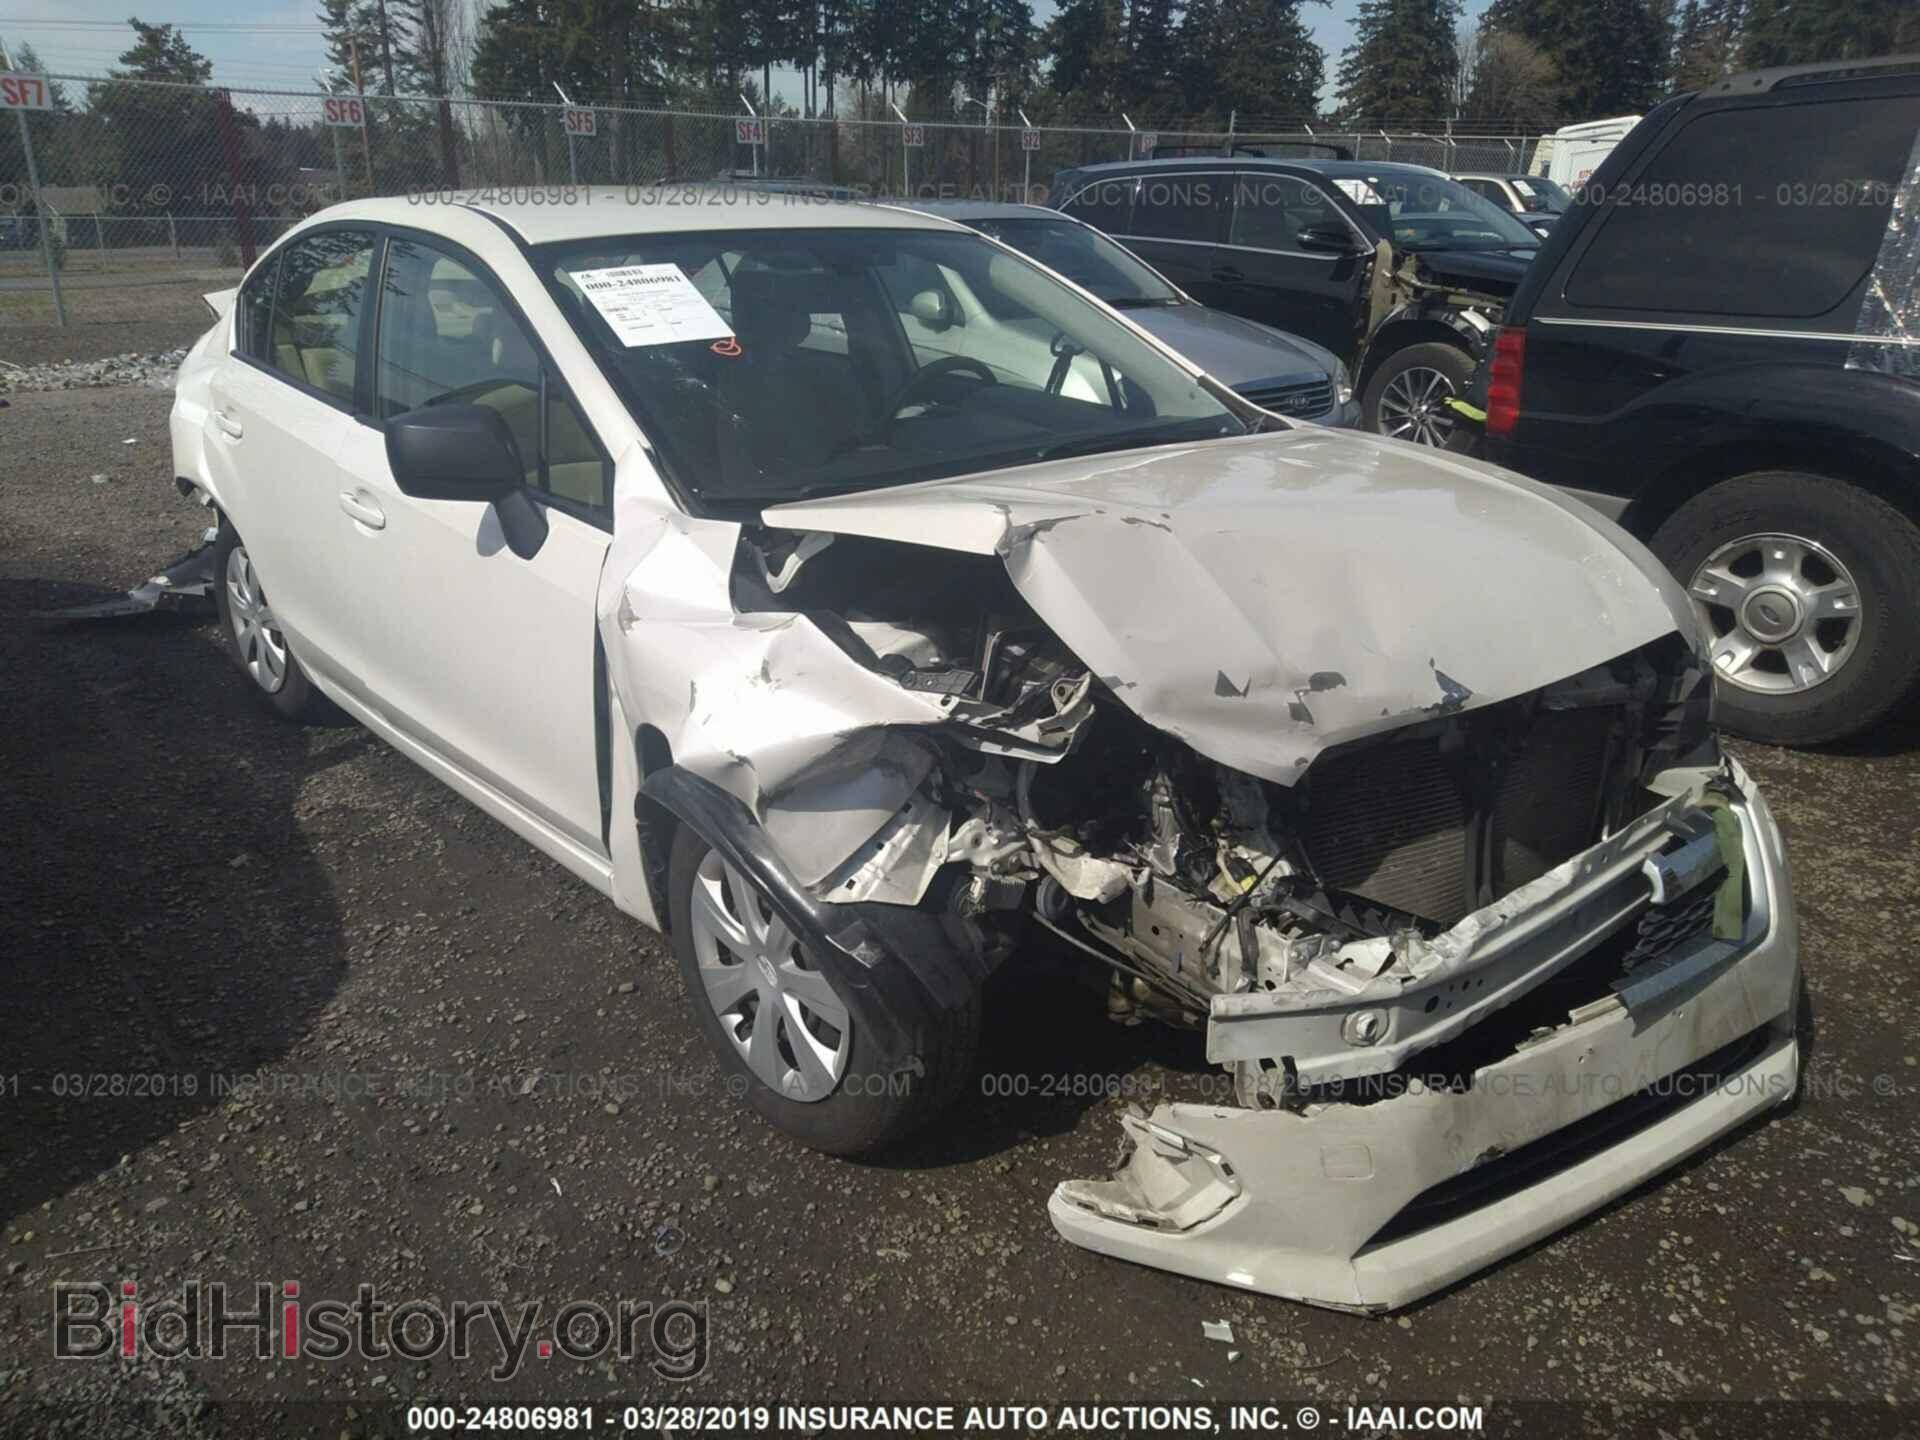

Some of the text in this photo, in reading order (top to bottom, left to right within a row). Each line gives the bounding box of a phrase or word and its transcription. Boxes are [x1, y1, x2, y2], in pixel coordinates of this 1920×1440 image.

[1, 78, 43, 106] SF7
[326, 100, 361, 123] SF6
[567, 111, 593, 133] SF5
[738, 122, 761, 142] SF4
[904, 126, 923, 144] SF3
